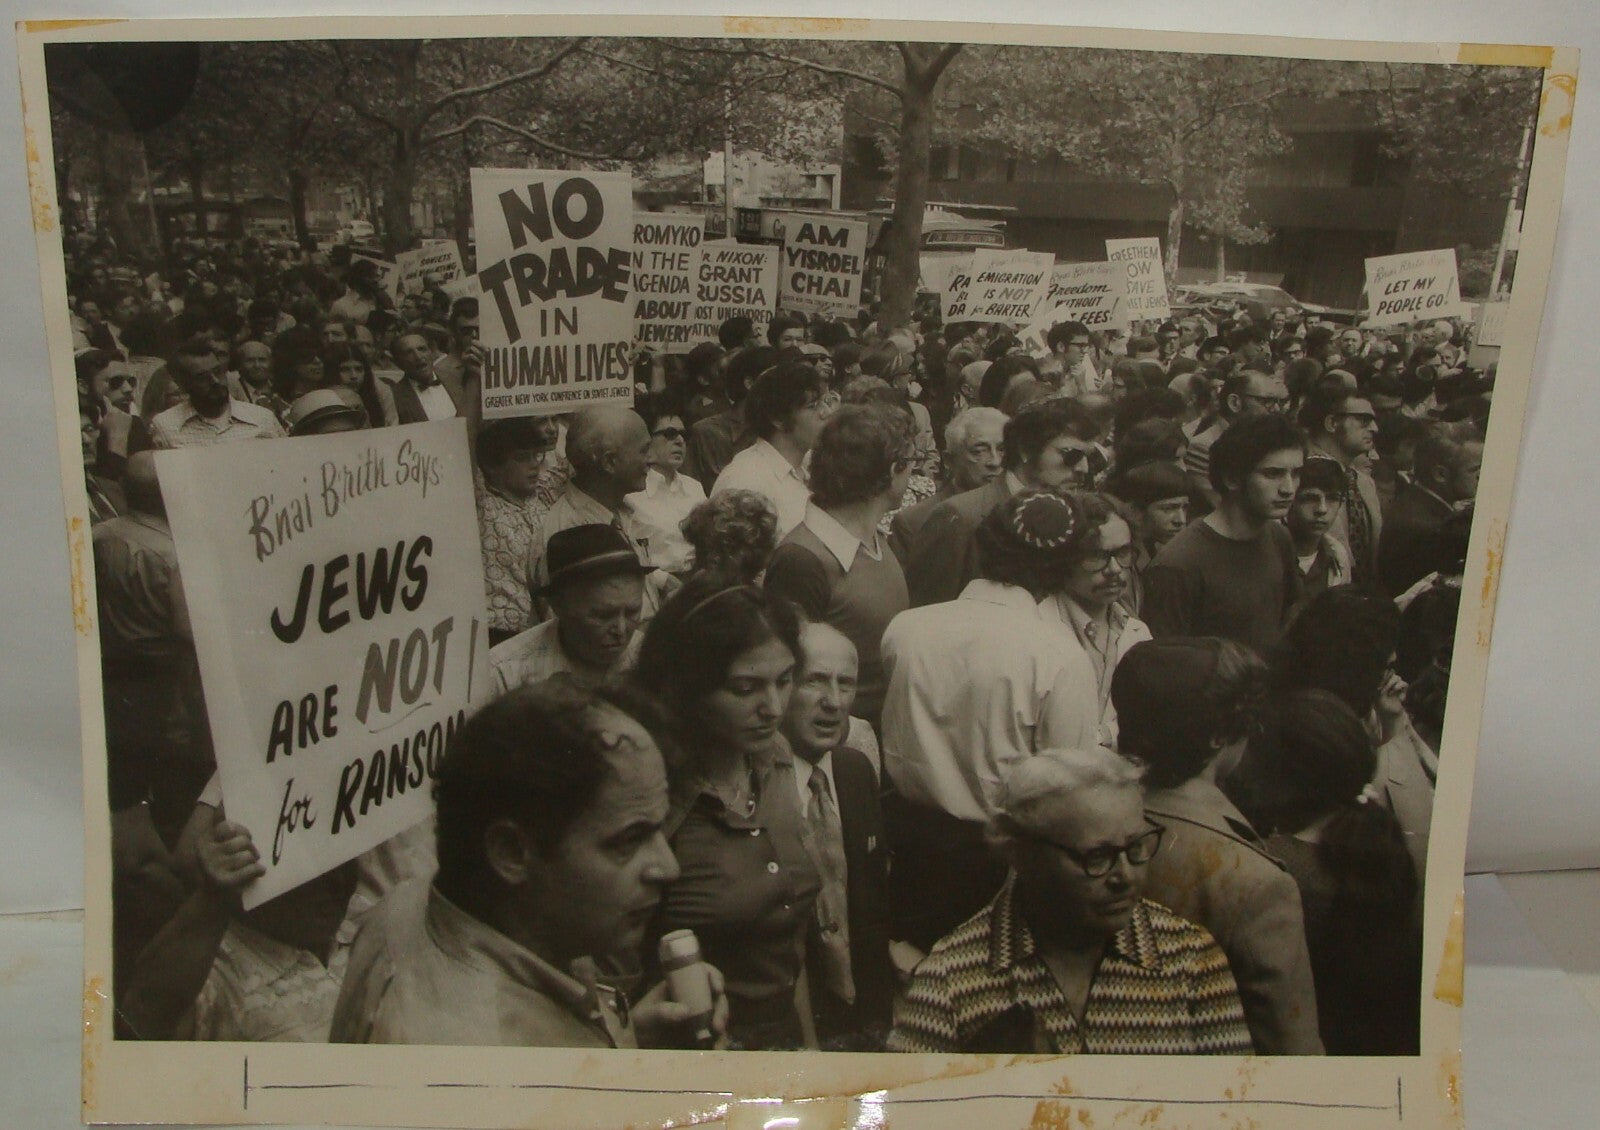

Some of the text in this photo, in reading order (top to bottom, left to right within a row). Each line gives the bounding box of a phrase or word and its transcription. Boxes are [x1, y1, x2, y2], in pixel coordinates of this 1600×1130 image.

[499, 177, 604, 250] NO
[633, 224, 700, 247] ROMYKO
[795, 223, 849, 248] AM
[633, 251, 690, 271] N THE
[786, 247, 861, 275] YISROEL
[1127, 261, 1152, 278] OW
[699, 264, 763, 284] GRANT
[791, 271, 851, 298] CHAI
[977, 271, 1044, 286] EMIGRATION
[478, 246, 632, 344] TRADE
[697, 283, 766, 306] RUSSIA
[983, 287, 1034, 301] IS NOT
[1046, 282, 1112, 300] Freedom
[1384, 276, 1436, 295] LET MY
[634, 300, 692, 320] ABOUT
[694, 306, 714, 320] OST
[1376, 294, 1423, 316] PEOPLE
[541, 306, 578, 337] IN
[691, 323, 719, 338] ATION
[634, 323, 692, 343] JEWERY
[484, 341, 629, 389] HUMAN LIVES
[485, 395, 513, 408] GREATER
[515, 394, 530, 405] NEW
[532, 392, 549, 402] YORK
[270, 535, 433, 644] JEWS
[266, 684, 338, 764] ARE
[272, 777, 318, 866] for
